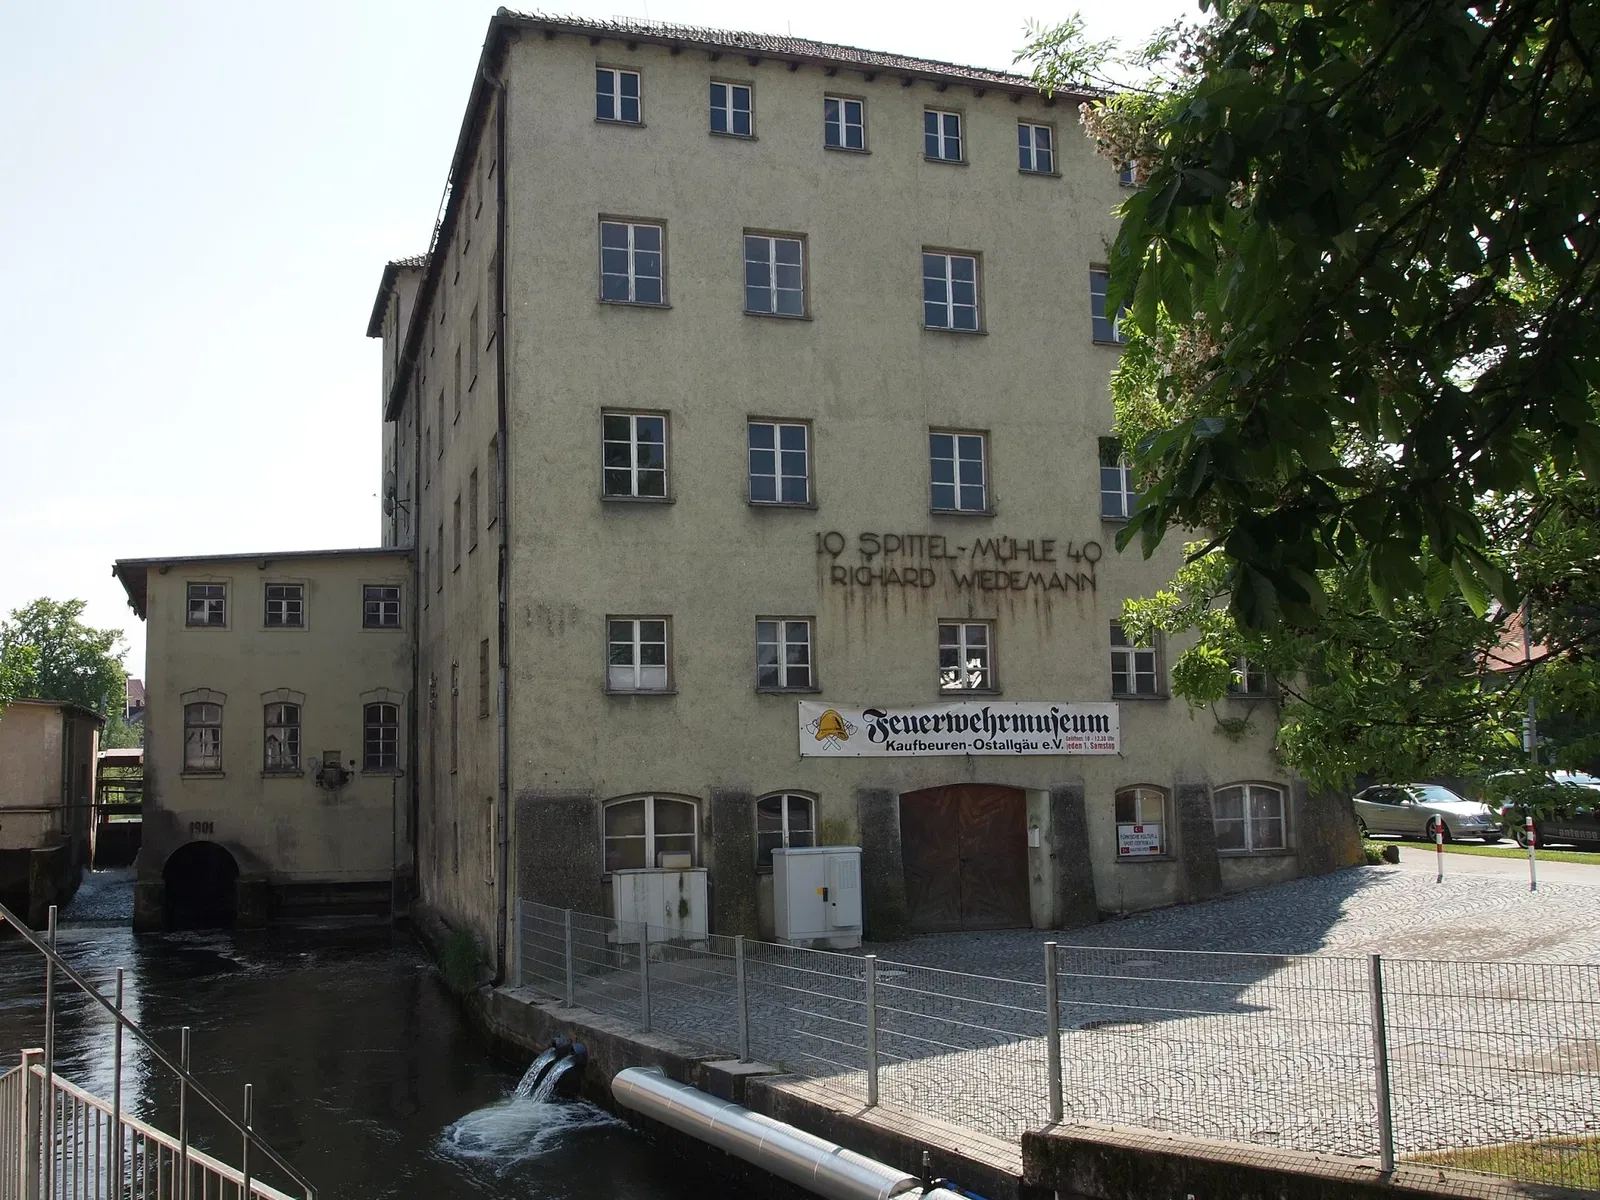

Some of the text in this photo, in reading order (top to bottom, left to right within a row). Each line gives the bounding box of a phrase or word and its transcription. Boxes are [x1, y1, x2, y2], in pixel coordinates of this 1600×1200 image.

[830, 565, 1097, 592] RICHARD WIEDEMANN
[885, 738, 1064, 753] Kaufbeuren-Ostallgäu e.V.
[1066, 742, 1082, 750] jeden
[1090, 742, 1116, 750] Samstag
